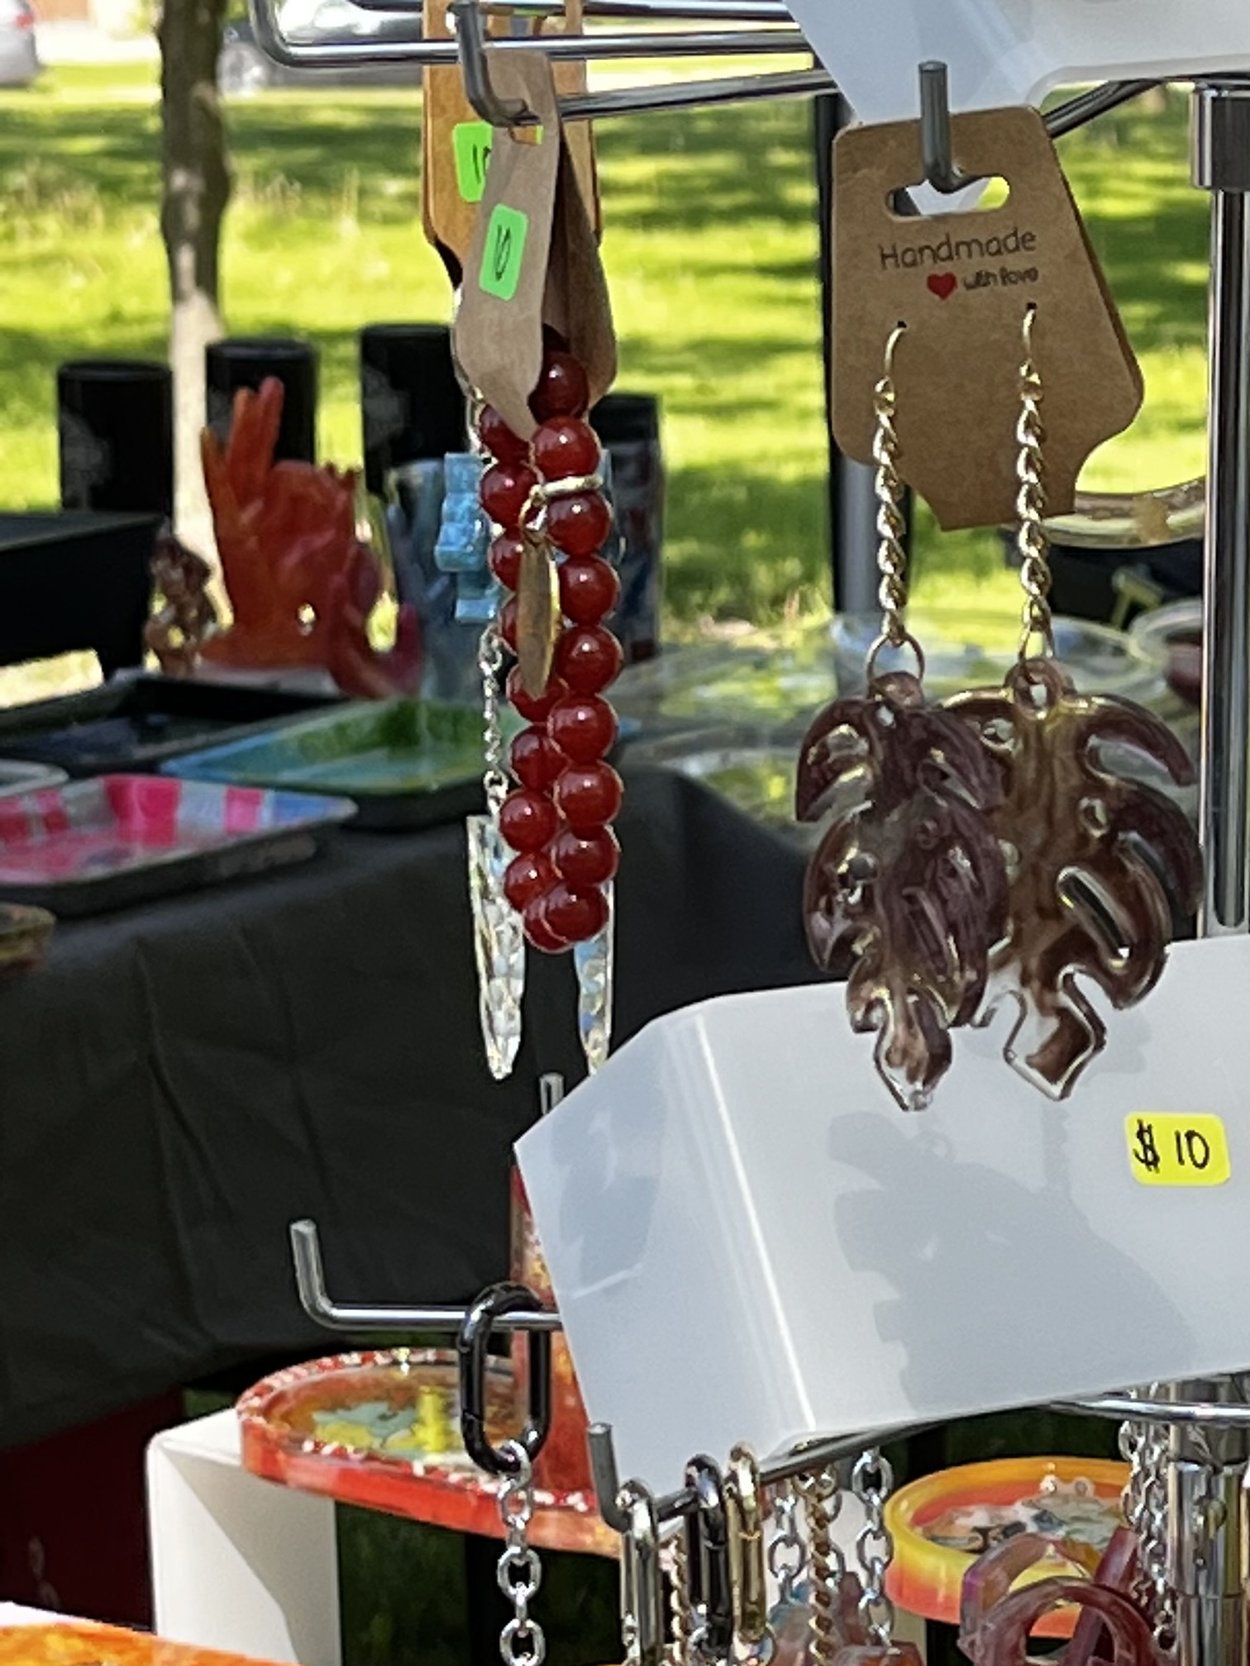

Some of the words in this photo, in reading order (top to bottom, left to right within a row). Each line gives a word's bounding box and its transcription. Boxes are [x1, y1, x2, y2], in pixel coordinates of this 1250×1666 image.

[878, 226, 1037, 270] Handmade
[963, 269, 998, 290] with
[999, 265, 1040, 287] love
